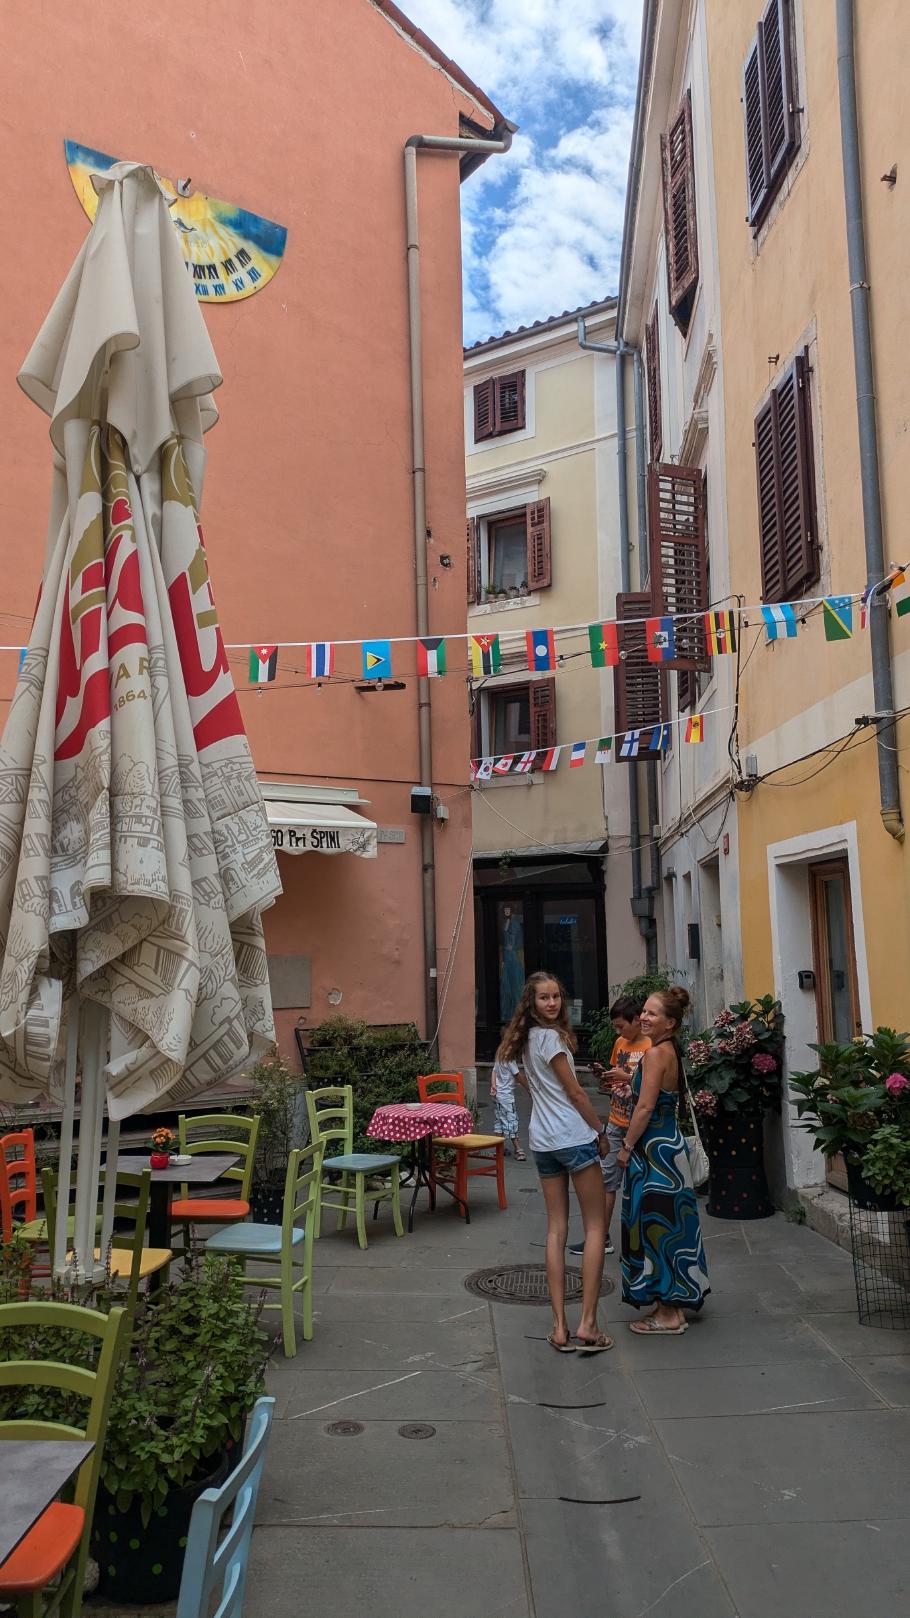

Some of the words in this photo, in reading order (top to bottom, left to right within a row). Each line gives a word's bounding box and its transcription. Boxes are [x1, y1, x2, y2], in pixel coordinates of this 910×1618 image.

[232, 276, 245, 292] XV
[287, 829, 306, 847] Pri
[310, 828, 340, 848] ŠPINI
